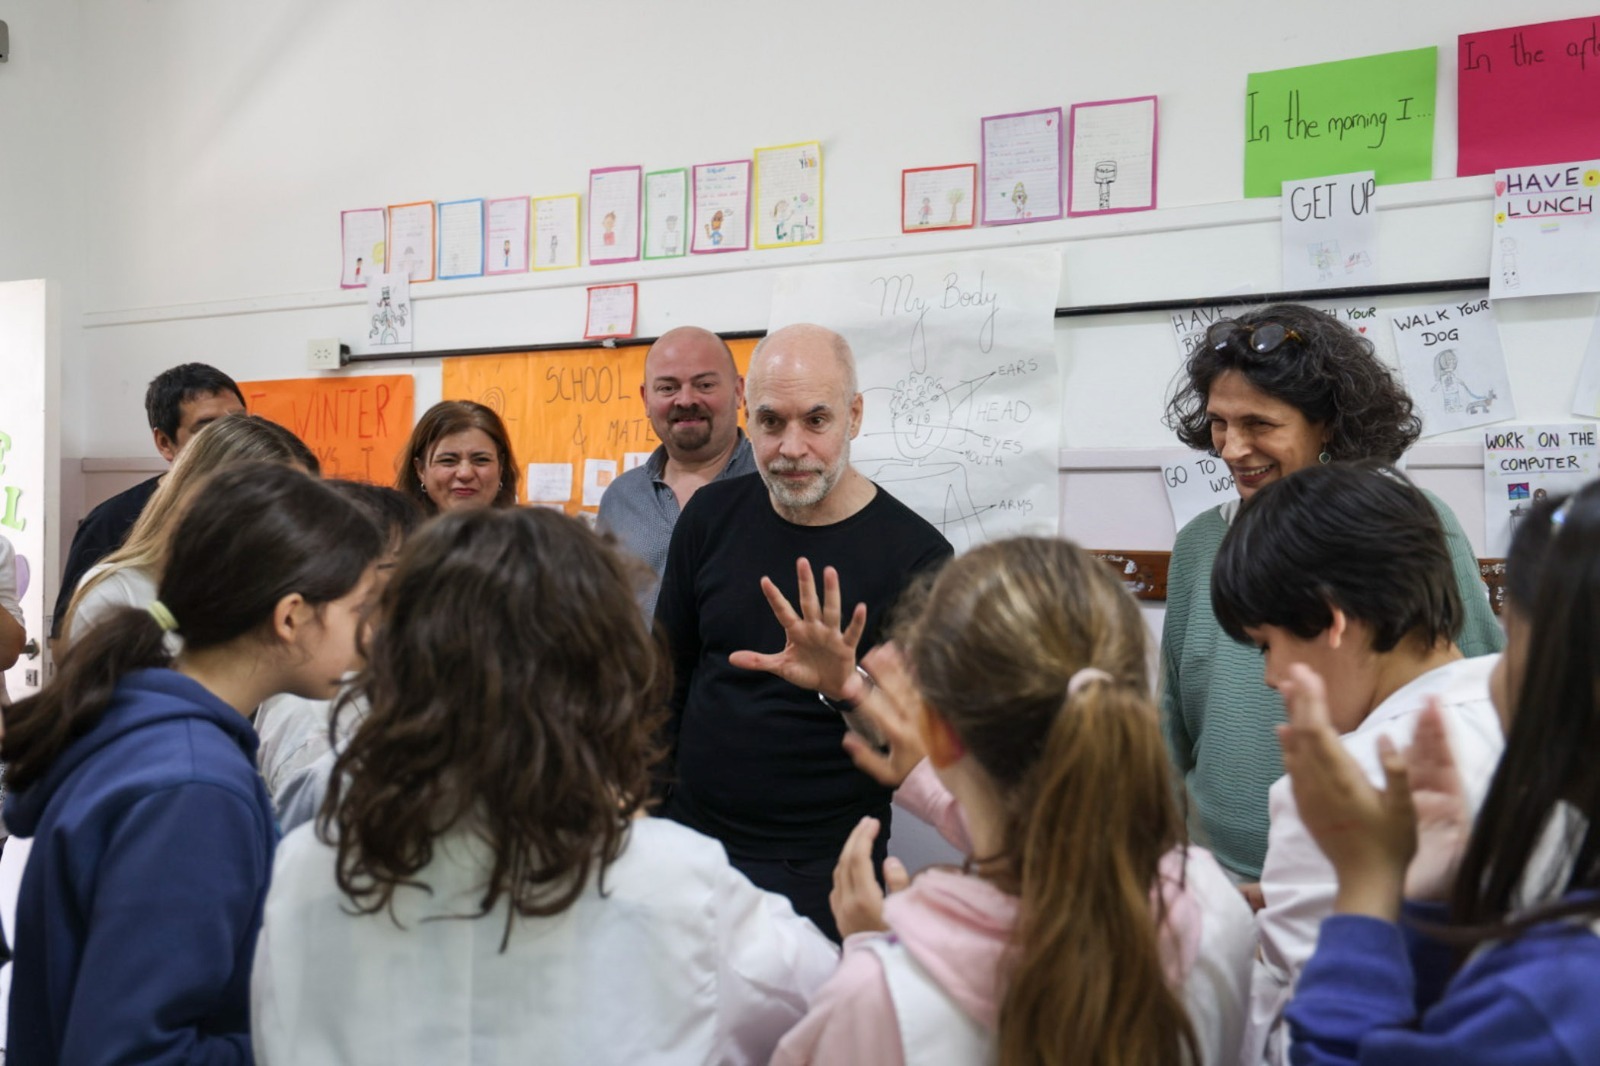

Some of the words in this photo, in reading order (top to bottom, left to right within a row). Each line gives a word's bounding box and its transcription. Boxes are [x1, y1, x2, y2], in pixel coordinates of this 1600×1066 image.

[1464, 40, 1492, 73] In
[1510, 31, 1545, 67] the
[1566, 21, 1600, 71] aft
[1247, 91, 1270, 143] In
[1284, 89, 1321, 140] the
[1328, 112, 1388, 149] morning
[1507, 167, 1580, 193] HAVE
[1291, 182, 1337, 222] GET
[1350, 178, 1376, 216] UP
[1508, 195, 1593, 217] LUNCH
[870, 273, 930, 375] My
[940, 270, 1000, 354] Body
[1346, 306, 1377, 320] YOUR
[1393, 309, 1450, 331] WALK
[1456, 299, 1490, 317] YOUR
[1421, 328, 1459, 346] DOG
[998, 358, 1039, 377] EARS
[546, 364, 631, 404] SCHOOL
[976, 400, 1032, 424] HEAD
[982, 434, 1024, 455] EYES
[1485, 432, 1525, 449] WORK
[1538, 432, 1560, 447] ON
[1568, 432, 1595, 446] THE
[1164, 465, 1188, 488] GO
[1195, 459, 1217, 475] TO
[1500, 455, 1580, 471] COMPUTER
